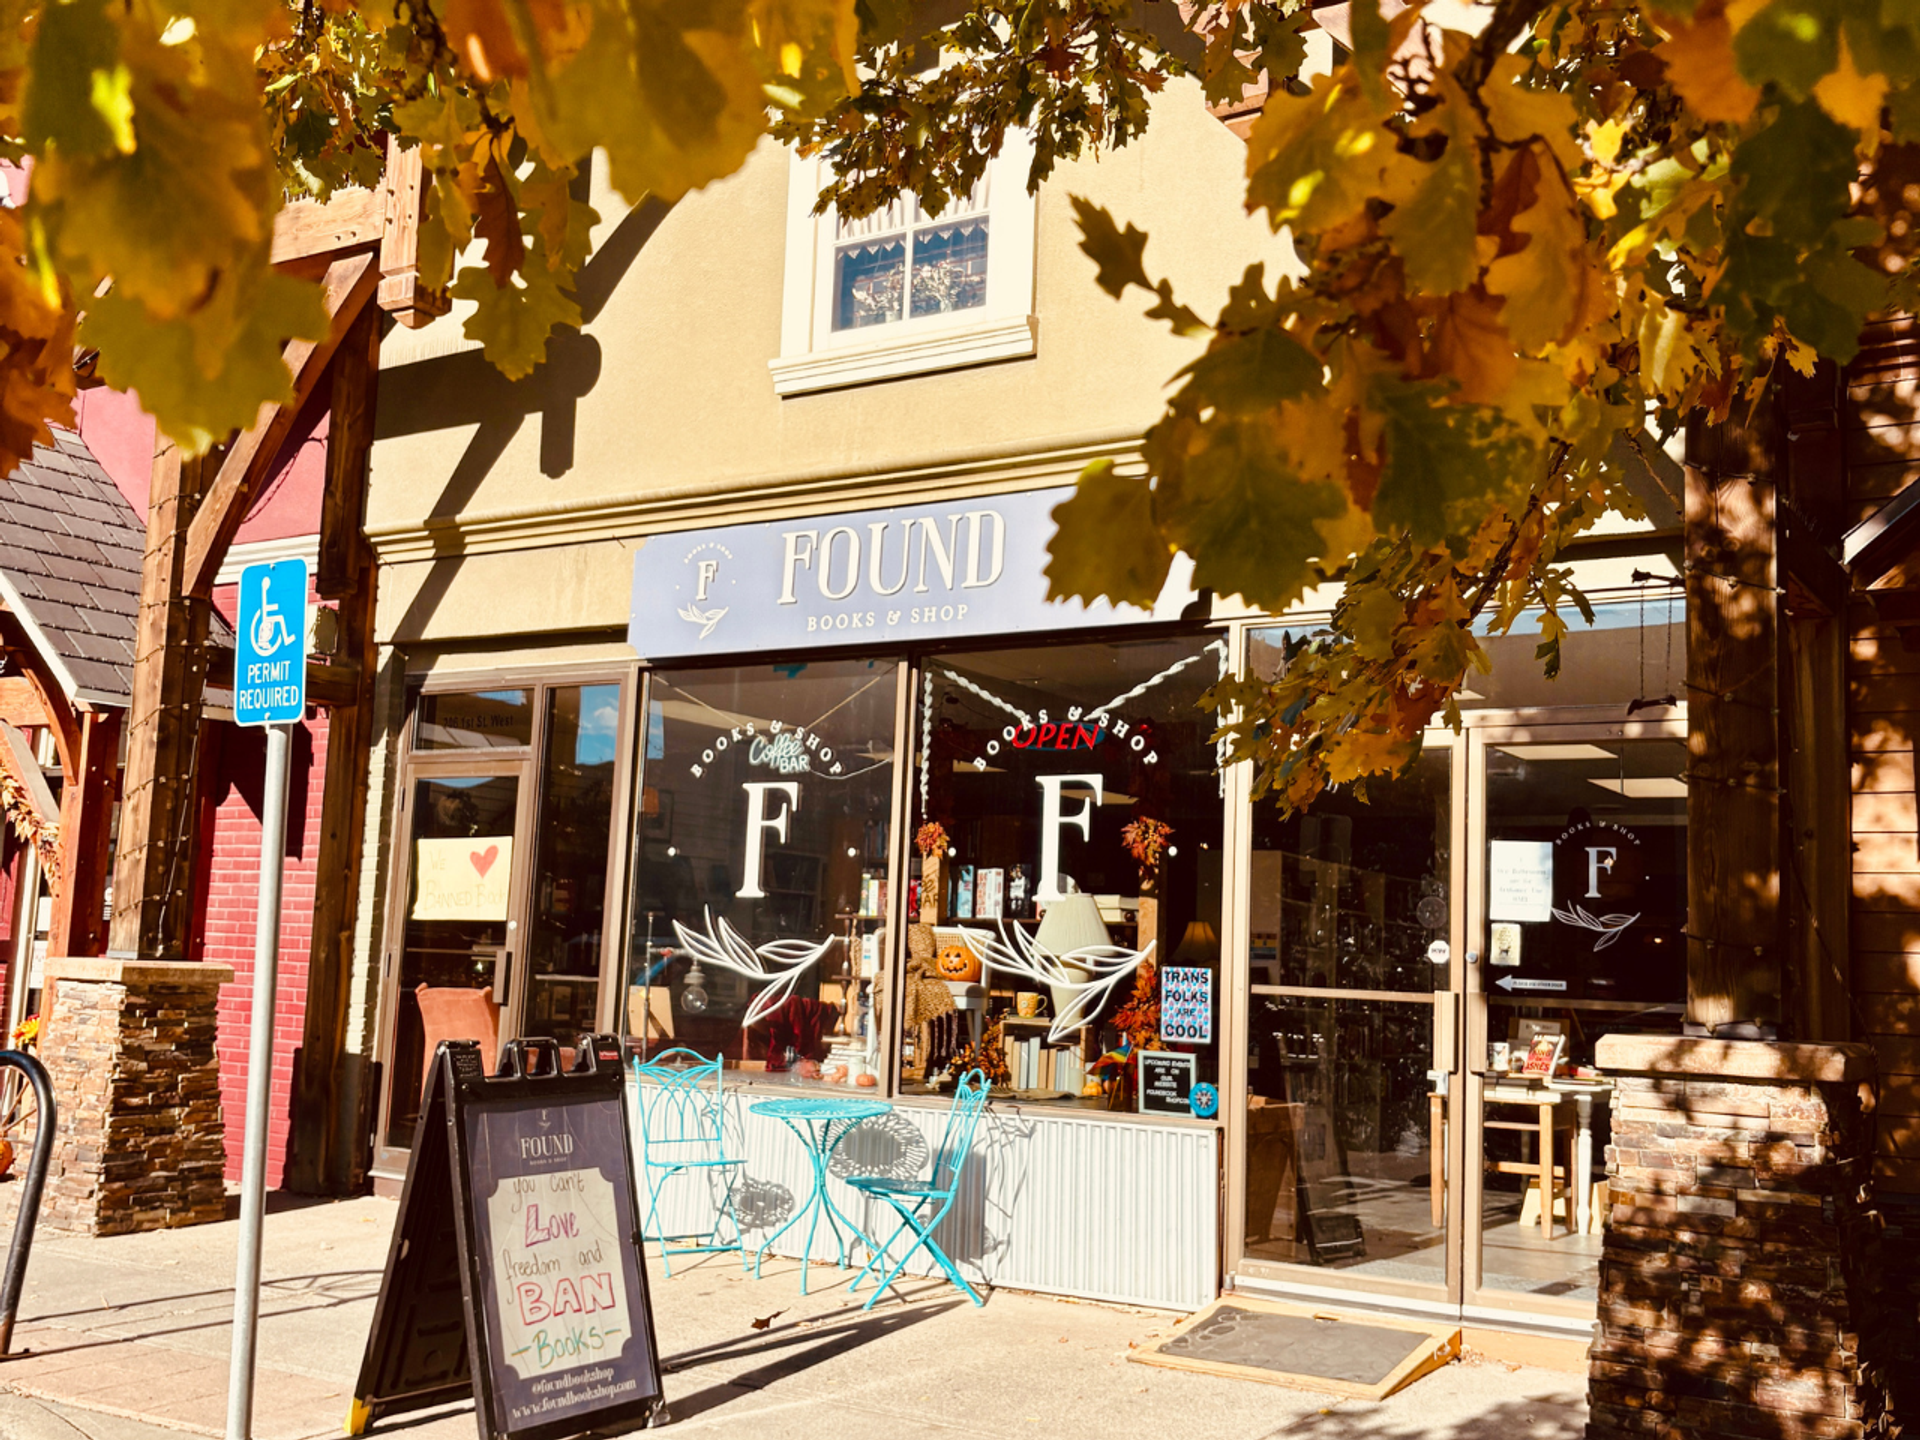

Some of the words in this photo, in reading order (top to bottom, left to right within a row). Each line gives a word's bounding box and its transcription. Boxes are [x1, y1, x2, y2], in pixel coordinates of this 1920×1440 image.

[777, 510, 1006, 605] FOUND
[696, 560, 719, 601] F
[807, 611, 875, 631] BOOKS
[886, 610, 901, 626] &
[910, 604, 969, 624] SHOP
[248, 661, 291, 684] PERMIT
[239, 685, 299, 710] REQUIRED
[491, 713, 514, 727] West
[690, 722, 755, 778] BOOKS
[770, 719, 783, 733] &
[794, 727, 842, 774] SHOP
[973, 709, 1048, 771] BOOKS
[1068, 706, 1082, 721] &
[1098, 712, 1158, 764] SHOP
[1012, 722, 1100, 750] OPEN
[749, 733, 806, 768] Coffee
[779, 754, 811, 774] BAR
[735, 782, 799, 898] F
[1031, 774, 1103, 901] F
[1612, 823, 1641, 846] SHOP
[1584, 847, 1617, 898] F
[1164, 971, 1209, 985] TRANS
[1165, 990, 1208, 1003] FOLKS
[1164, 1024, 1208, 1039] COOL
[521, 1133, 574, 1159] FOUND
[503, 1248, 561, 1305] freedom
[578, 1239, 604, 1266] and
[517, 1272, 616, 1326] BAN
[531, 1366, 614, 1394] @foundbookshop
[512, 1378, 637, 1419] www.foundbookshop.com
